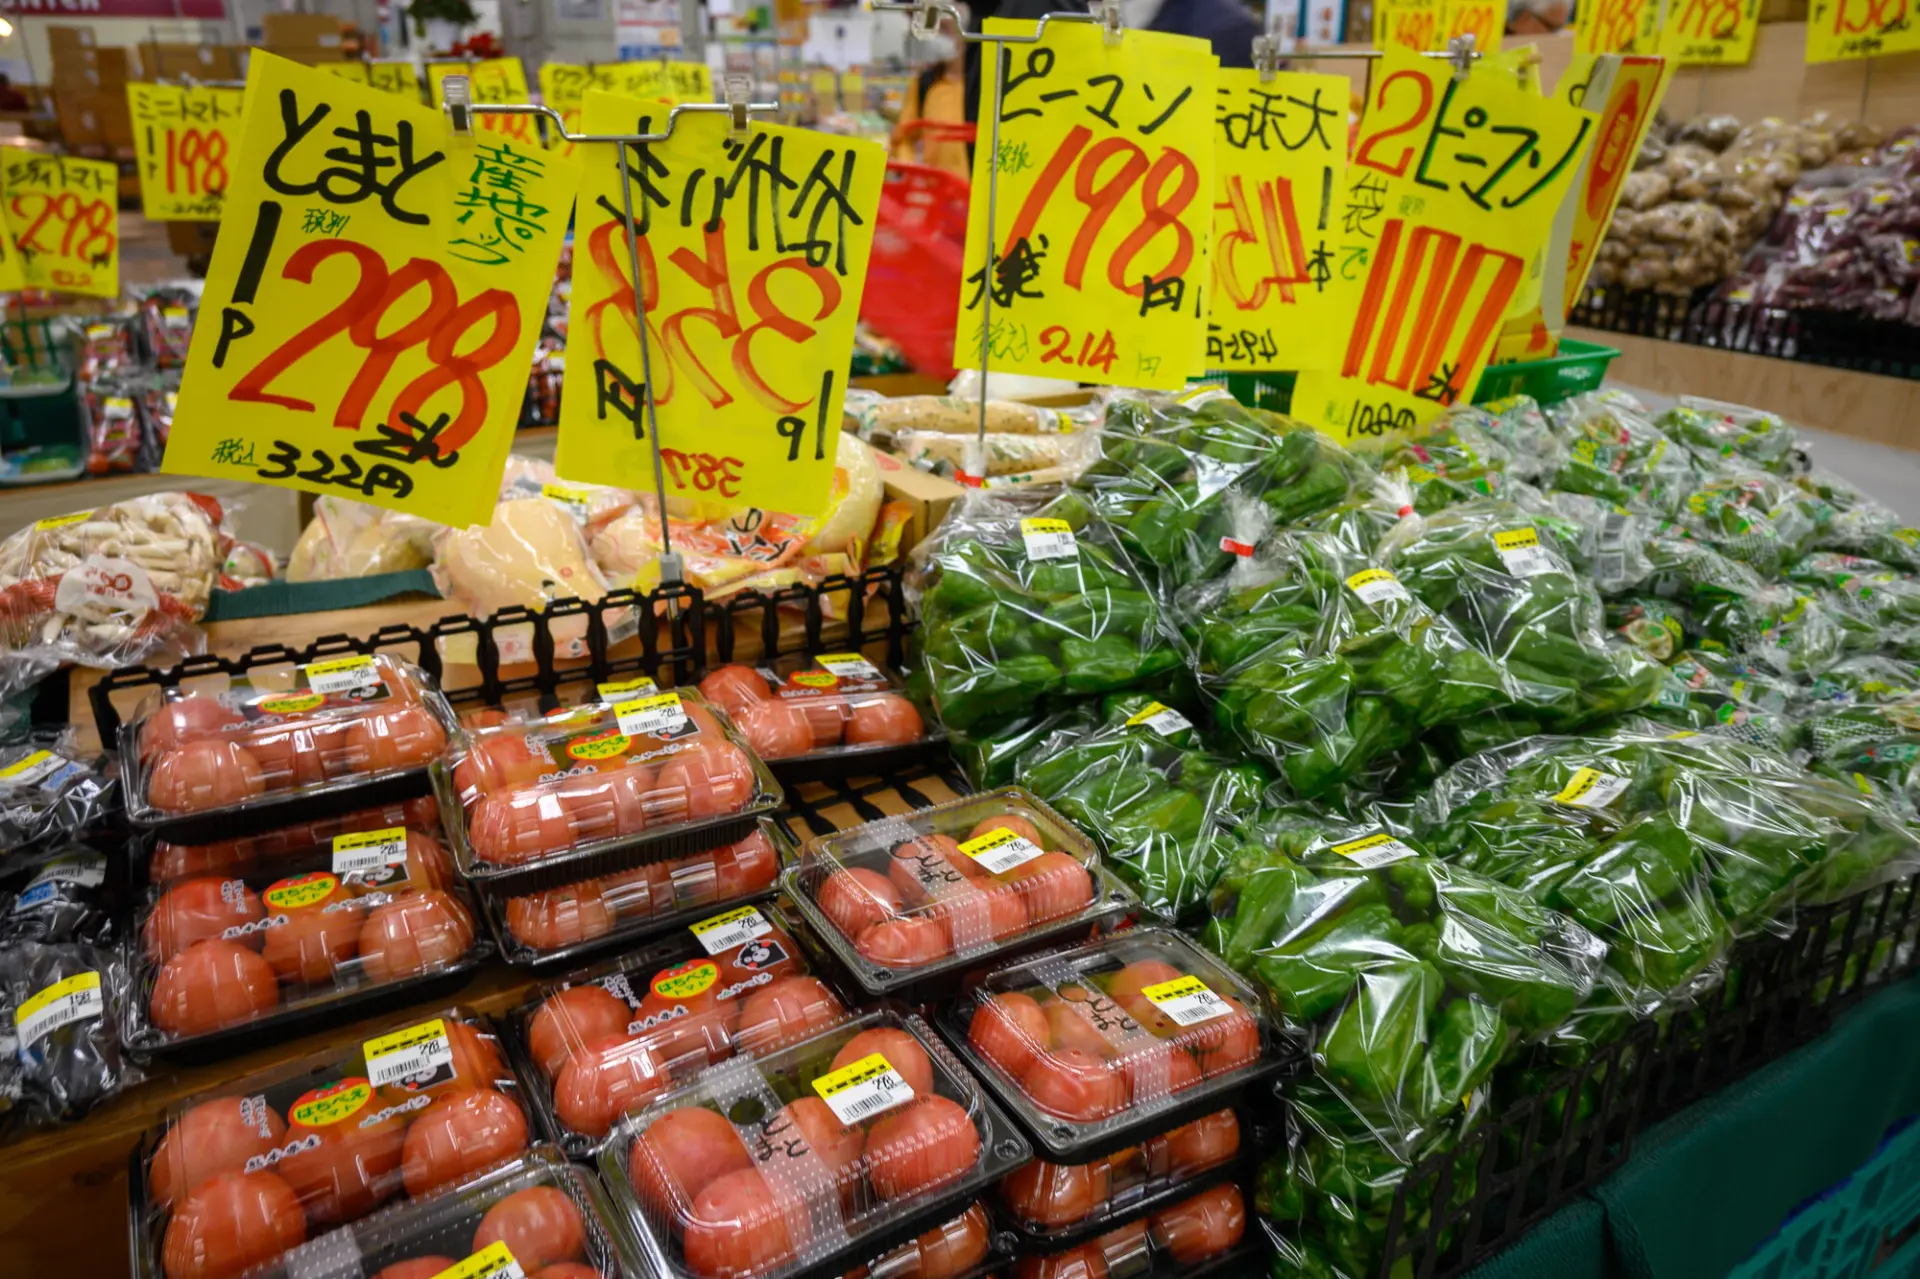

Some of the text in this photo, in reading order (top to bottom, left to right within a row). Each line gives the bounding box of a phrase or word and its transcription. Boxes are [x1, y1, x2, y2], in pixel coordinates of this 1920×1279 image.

[1000, 47, 1193, 135] ピーマン
[167, 129, 229, 195] 198
[263, 89, 445, 225] とまと
[1414, 78, 1592, 212] ピーマン
[12, 191, 117, 264] 298
[301, 208, 350, 237] 税別
[1000, 124, 1200, 298] 198
[1138, 275, 1186, 317] 円
[1342, 219, 1524, 406] 100
[228, 238, 521, 459] 298
[1039, 325, 1119, 375] 214
[257, 440, 414, 499] 322円
[297, 1087, 366, 1121] はちべえ
